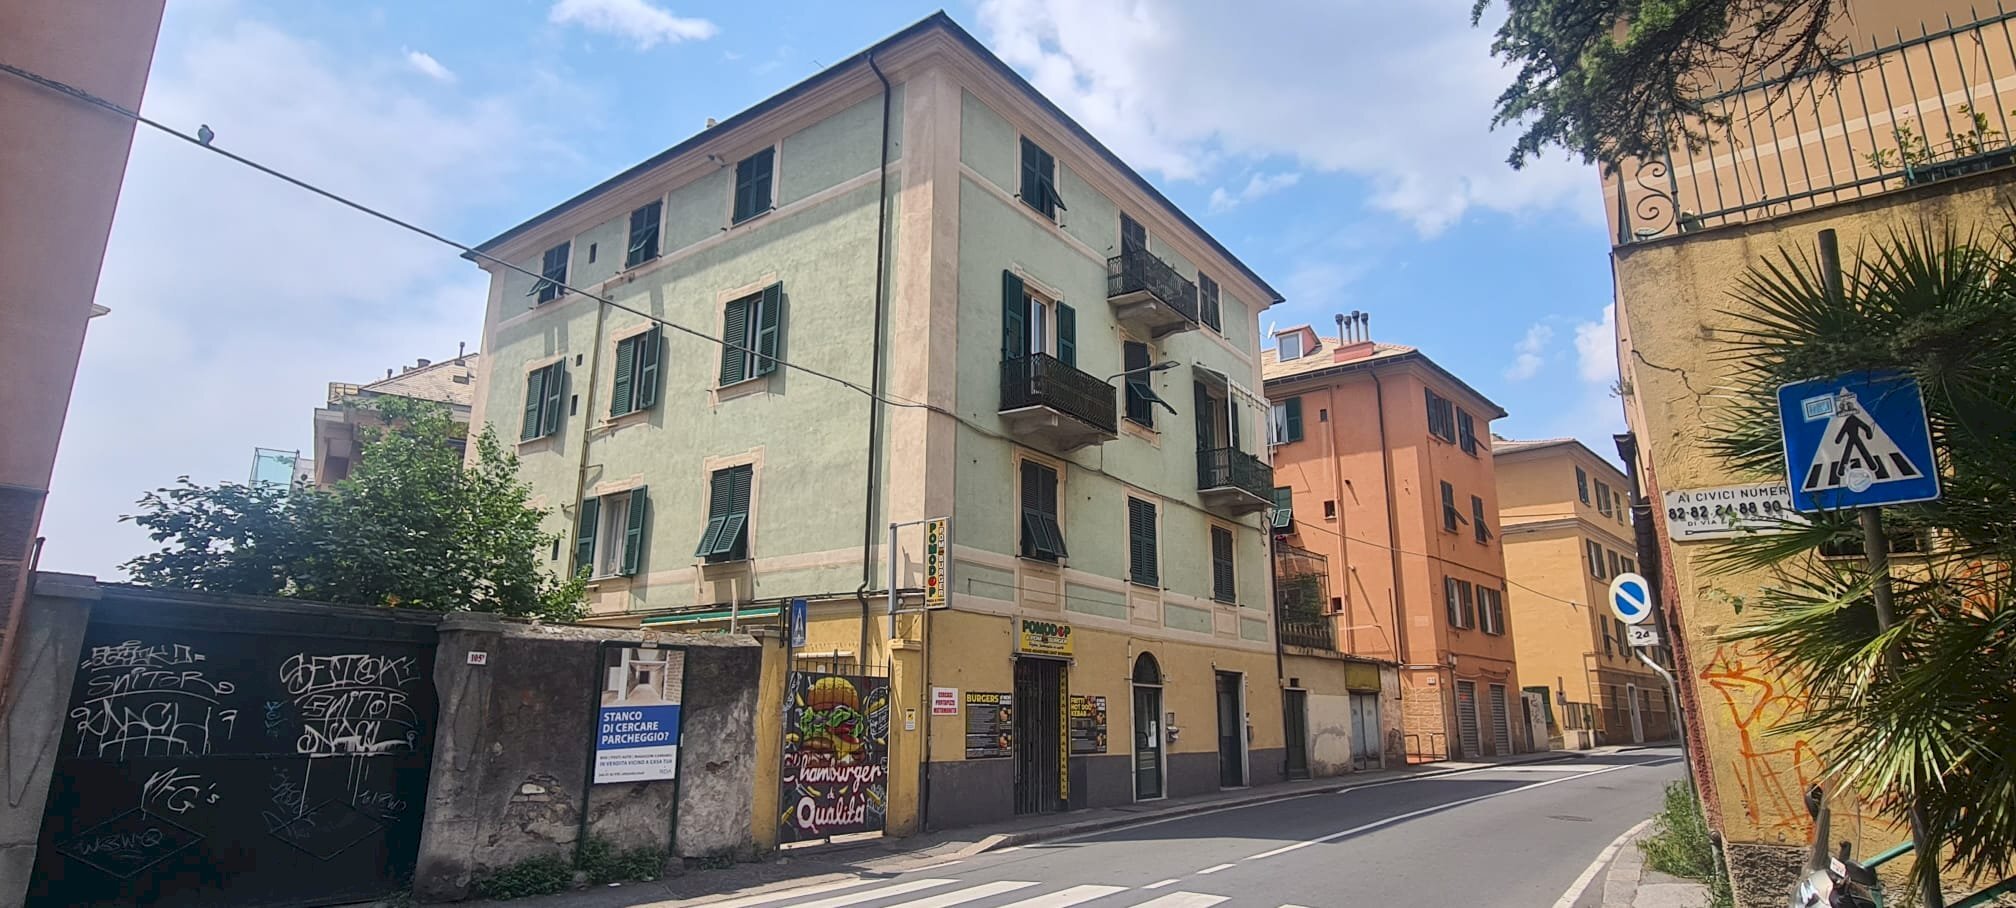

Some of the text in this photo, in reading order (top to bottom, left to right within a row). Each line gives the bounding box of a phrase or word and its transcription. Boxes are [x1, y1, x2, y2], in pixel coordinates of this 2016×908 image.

[1678, 486, 1788, 503] AI CIVICI NUMER
[966, 694, 1000, 703] BURGERS
[603, 711, 643, 722] STANCO
[603, 721, 659, 733] DI CERCARE
[601, 732, 669, 745] PARCHEGGIO?
[796, 793, 866, 834] Qualità
